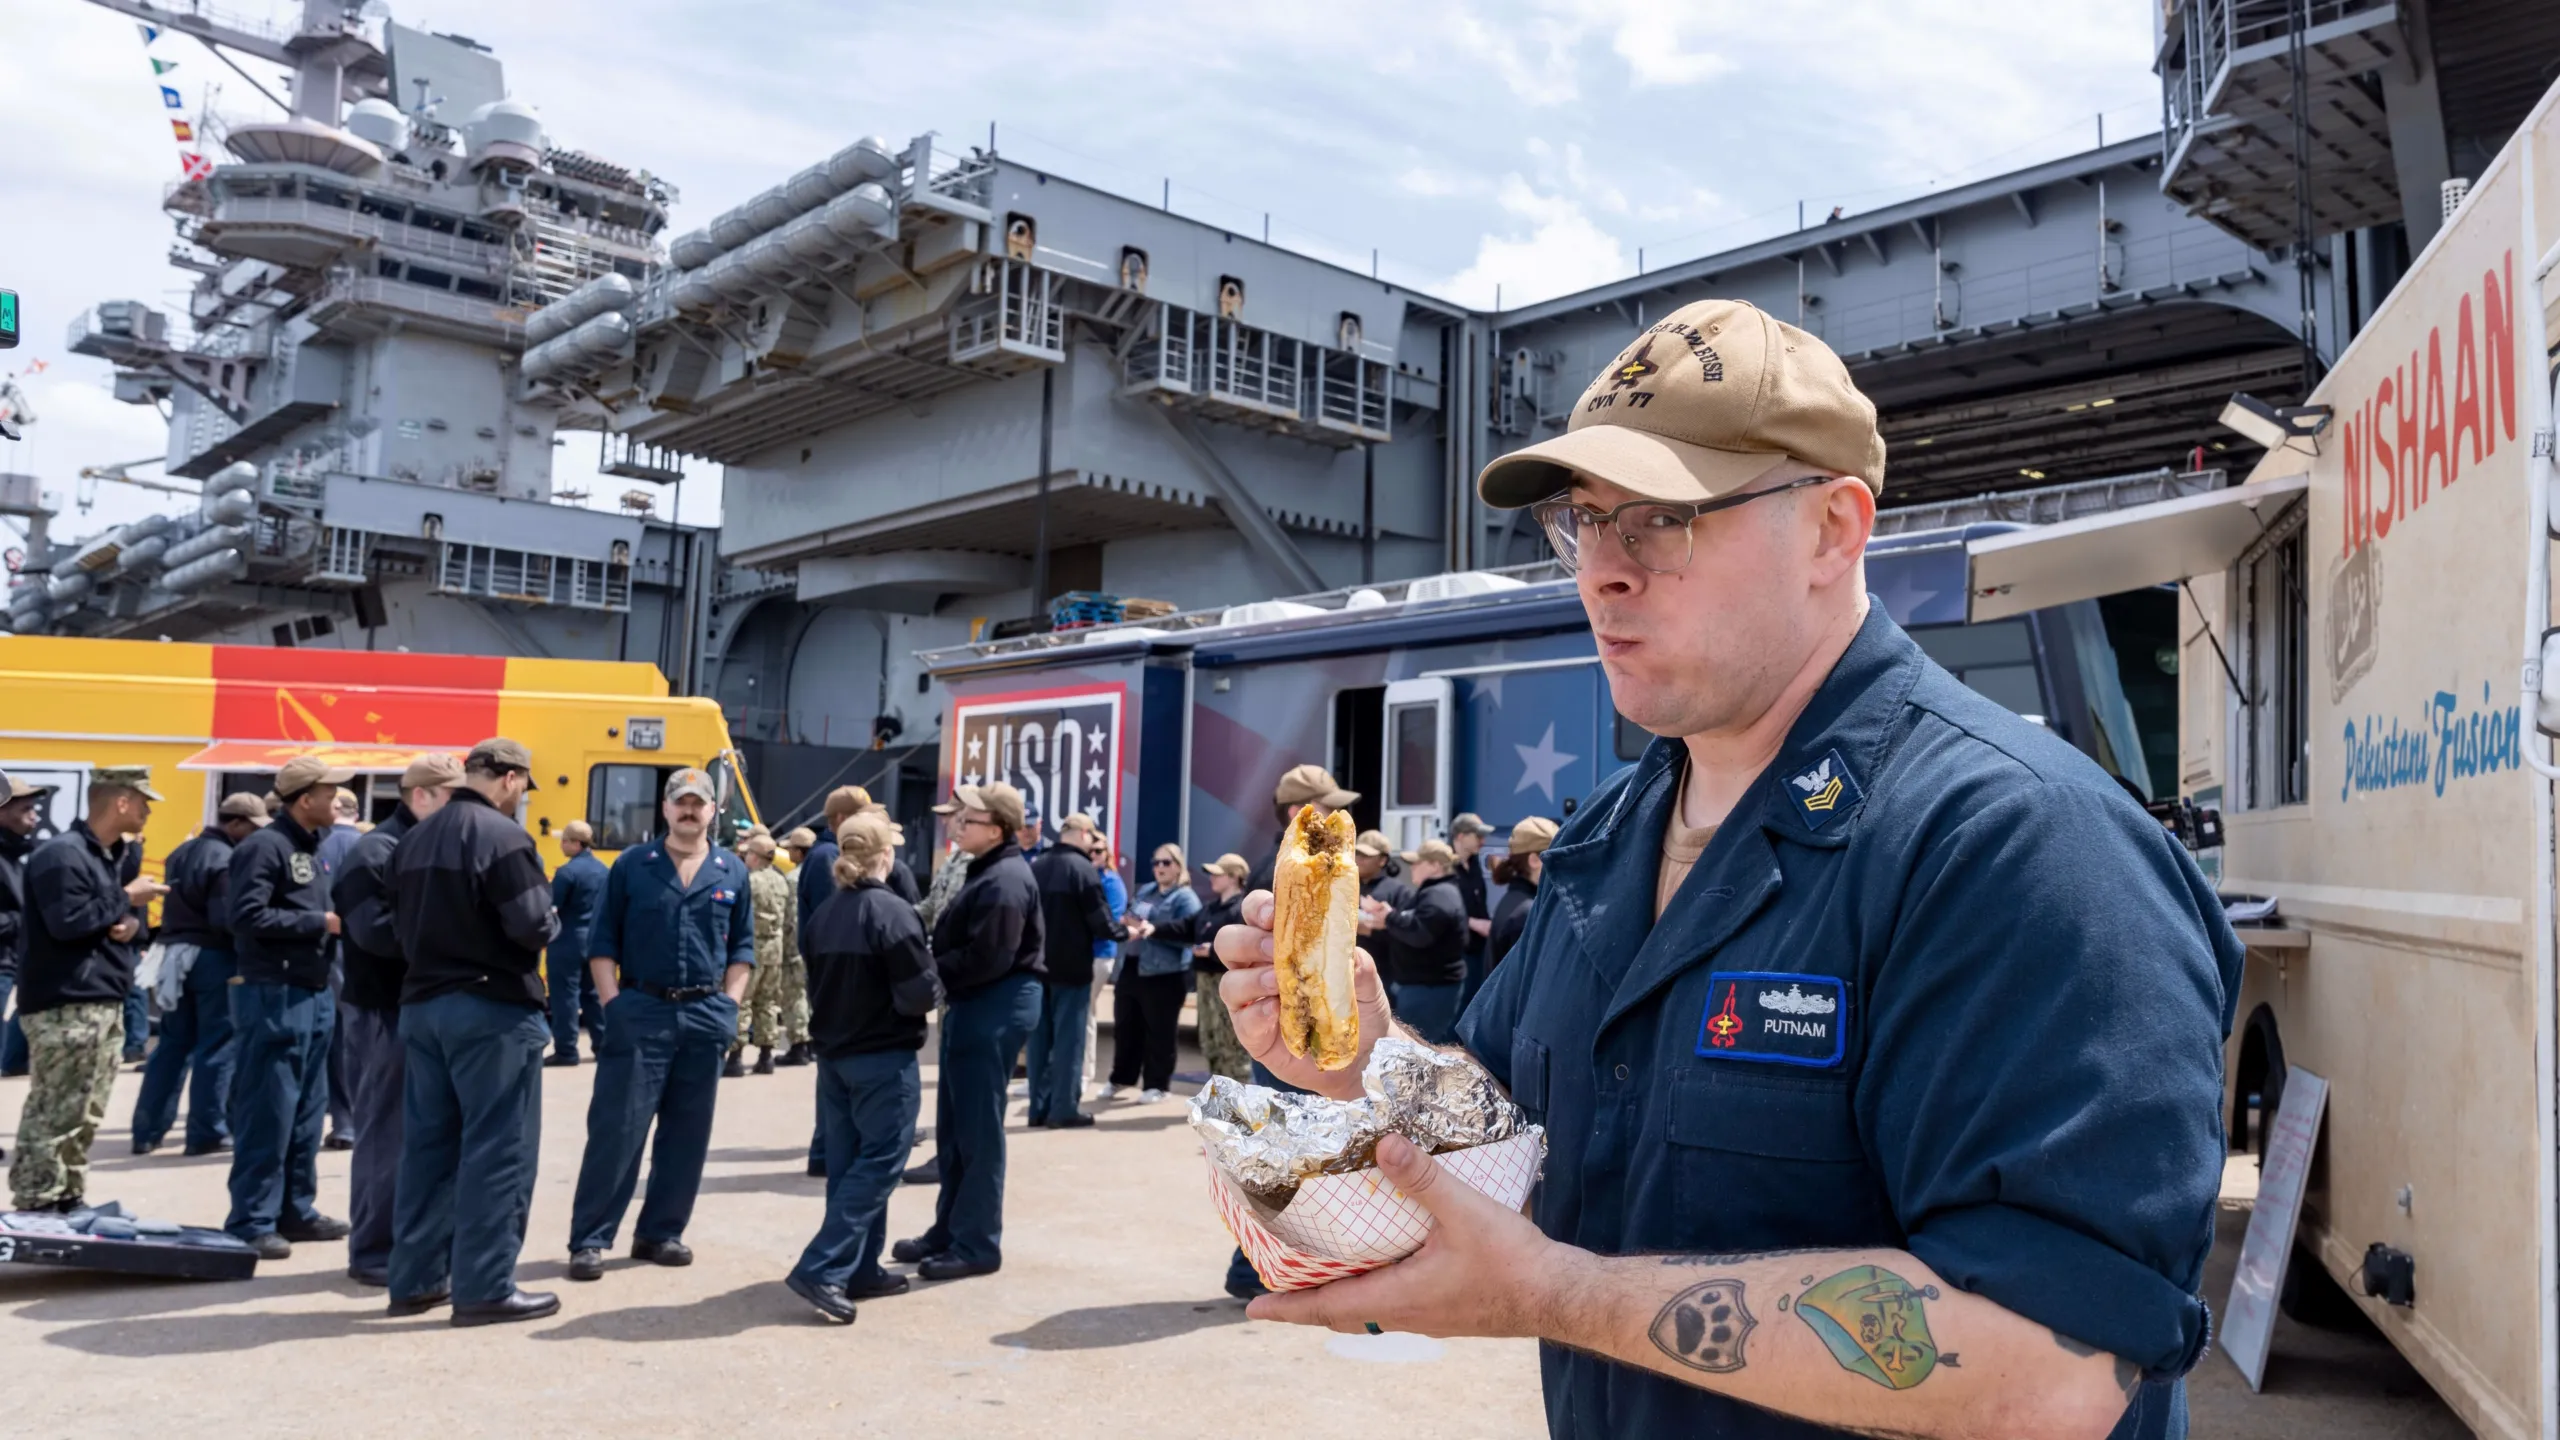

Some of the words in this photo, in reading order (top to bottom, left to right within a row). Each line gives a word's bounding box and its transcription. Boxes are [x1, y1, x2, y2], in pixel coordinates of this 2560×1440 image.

[1587, 392, 1618, 412] CVN
[1627, 391, 1655, 409] 77
[1693, 346, 1723, 382] BUSH
[2344, 248, 2516, 559] NISHAAN
[985, 718, 1082, 833] USO
[2342, 699, 2430, 803] Pakistani
[2432, 680, 2521, 798] Fusion
[1763, 1018, 1826, 1038] PUTNAM
